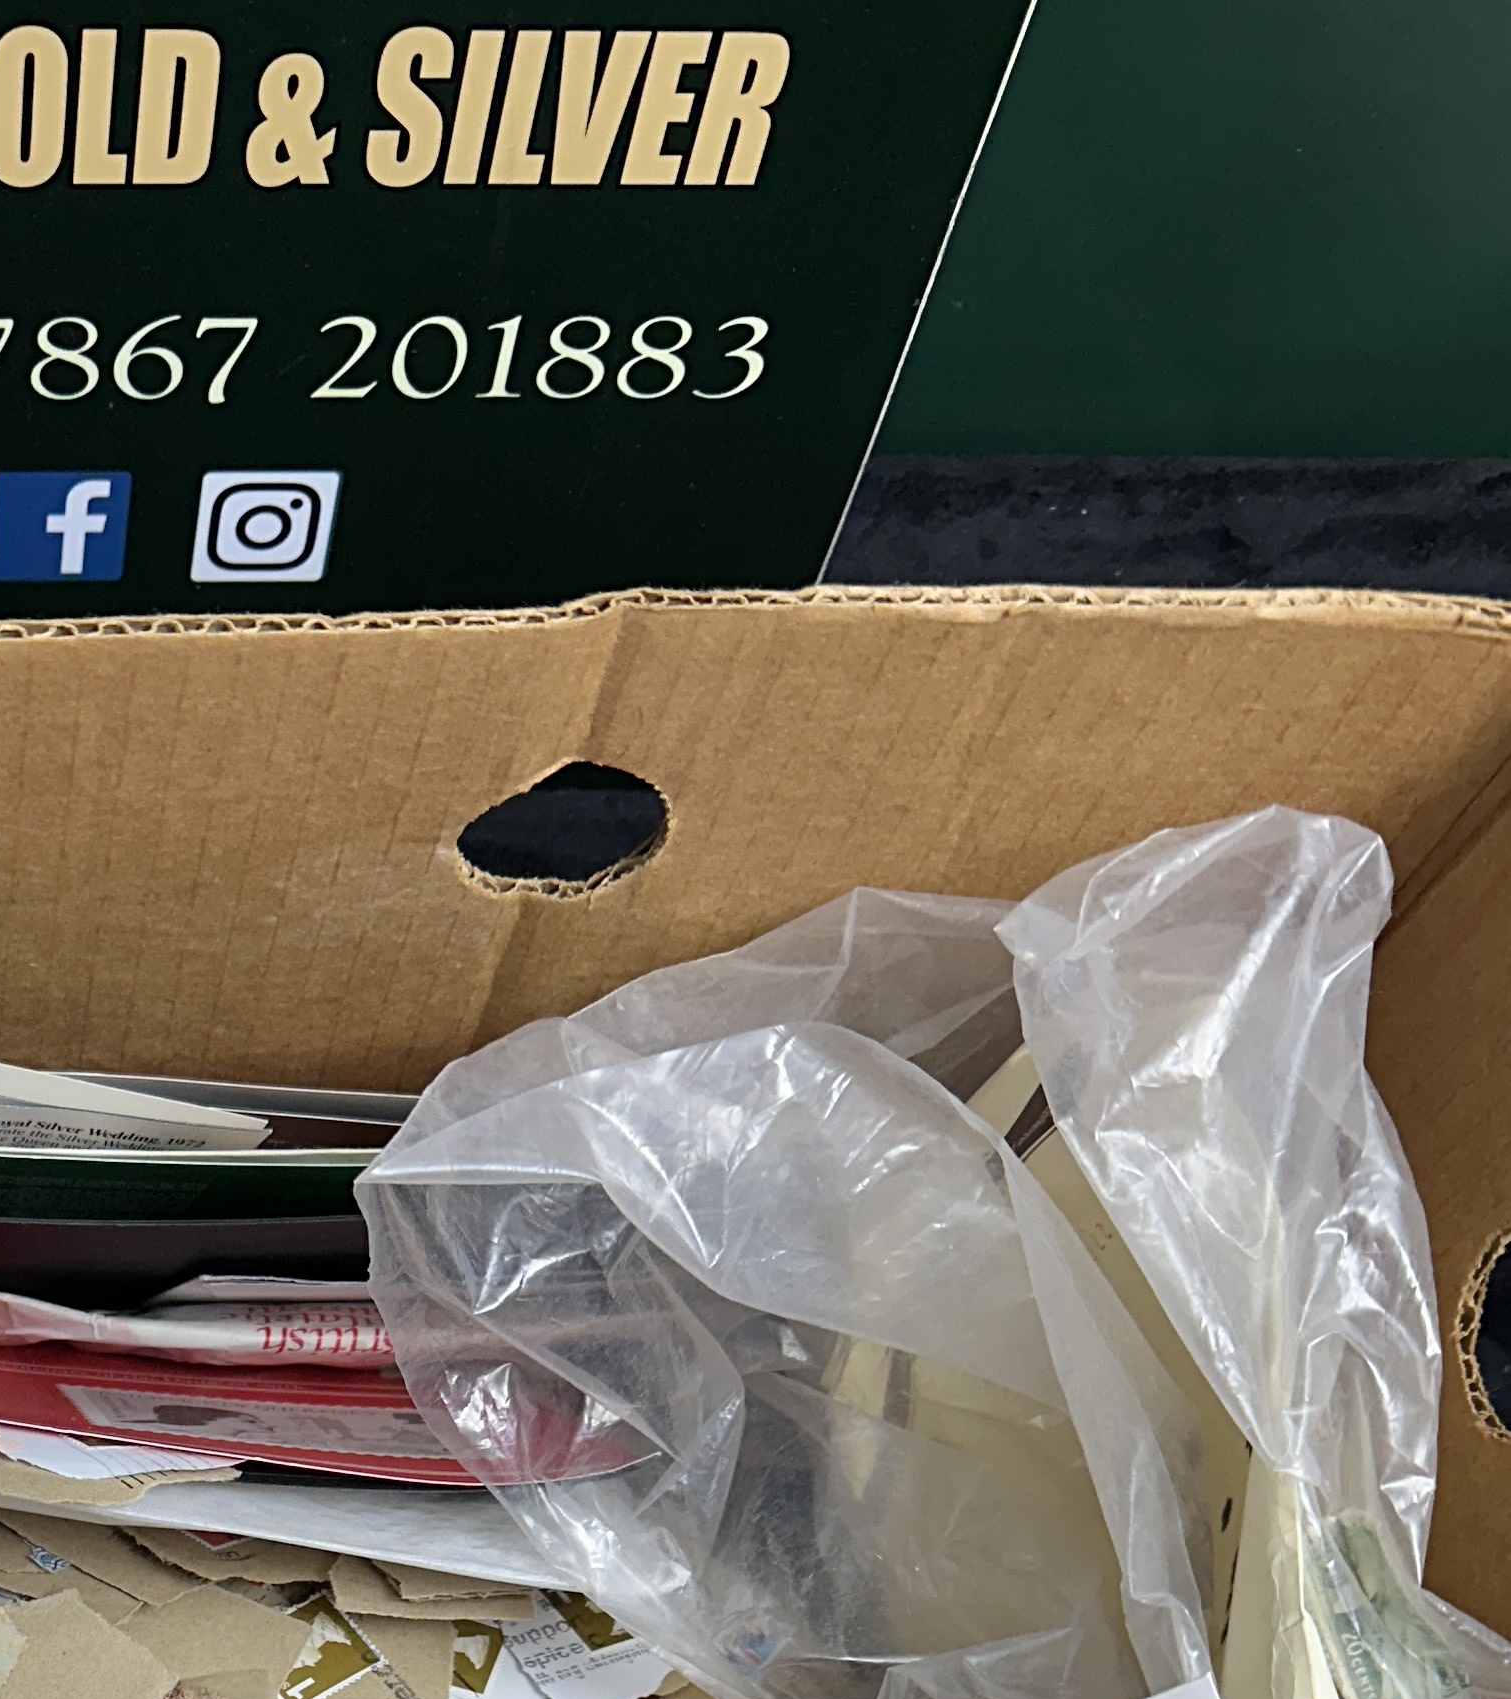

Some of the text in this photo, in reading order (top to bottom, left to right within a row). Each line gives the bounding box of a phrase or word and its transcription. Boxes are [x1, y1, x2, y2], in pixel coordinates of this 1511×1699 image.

[246, 52, 337, 187] &
[367, 26, 790, 188] SILVER
[311, 315, 769, 400] 201883
